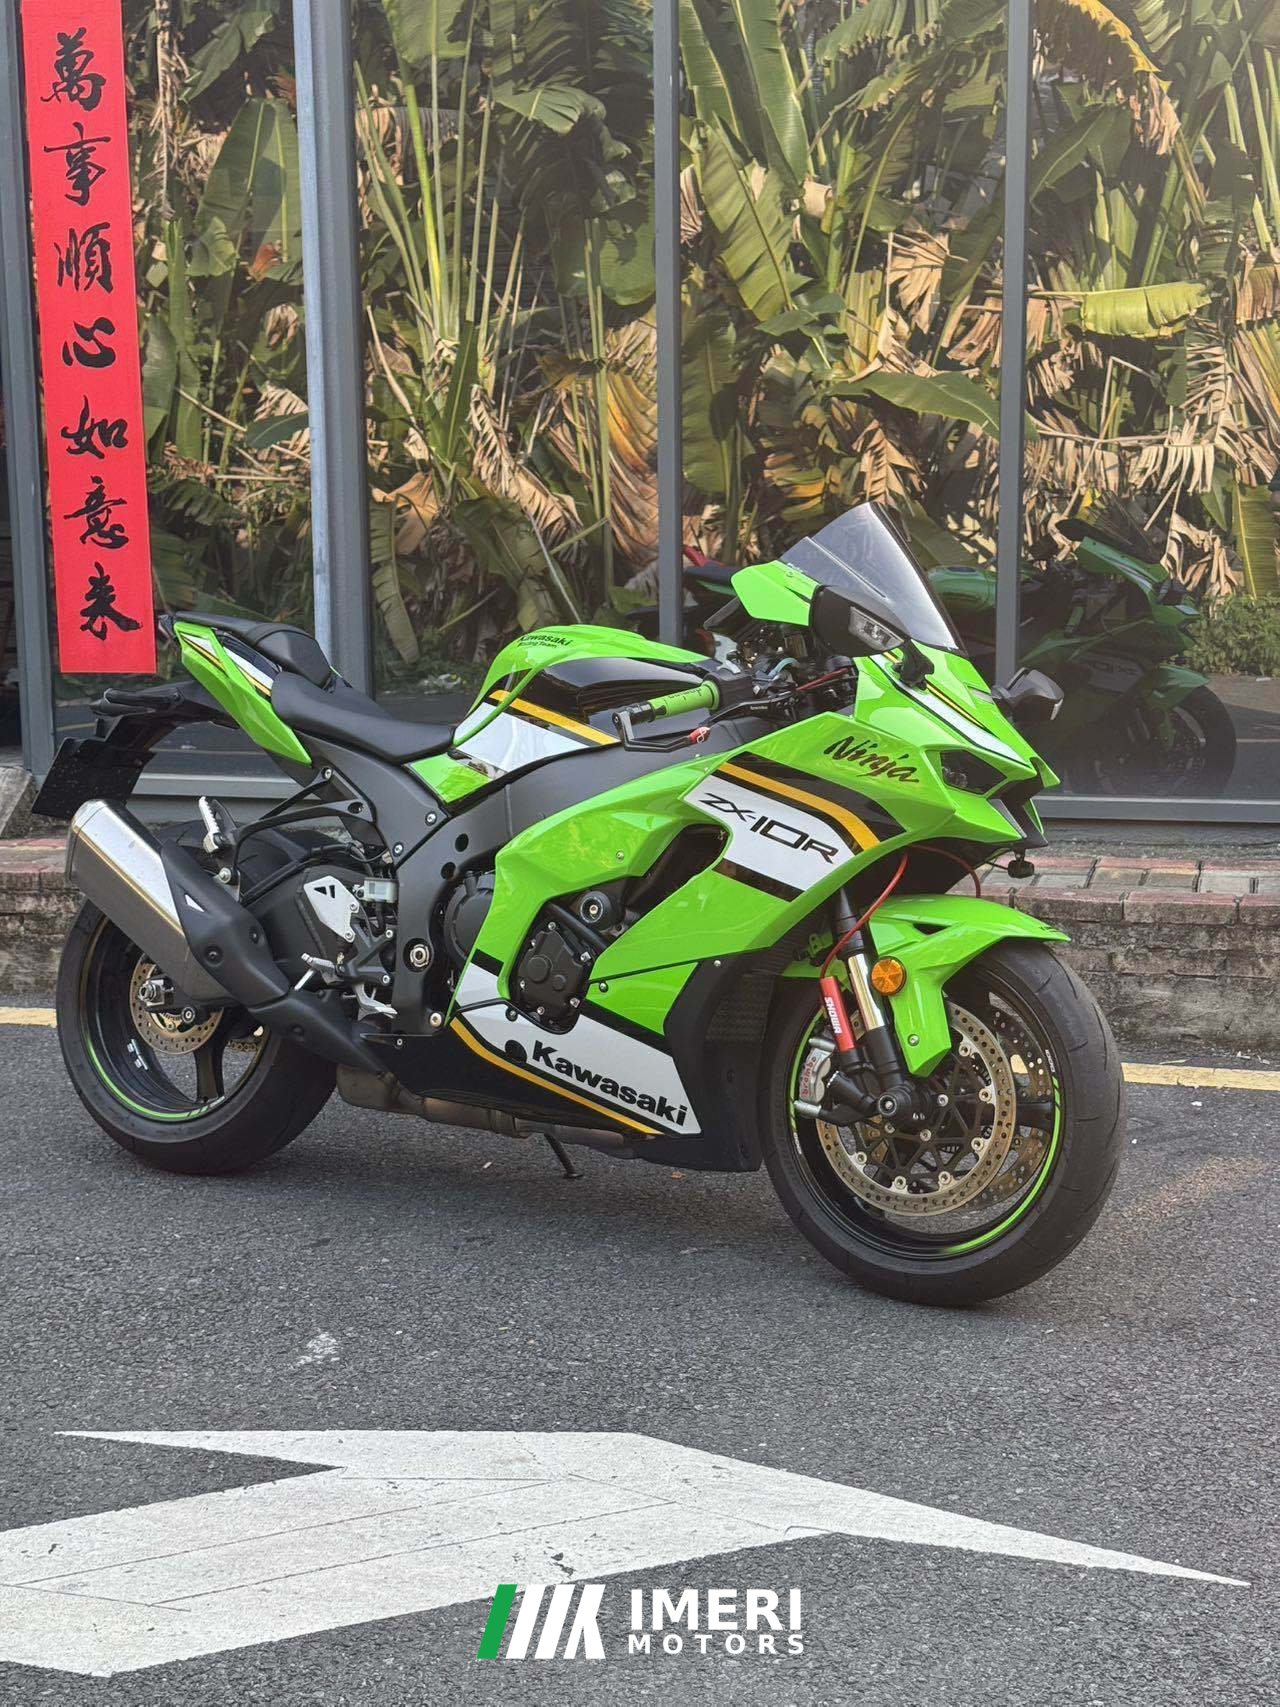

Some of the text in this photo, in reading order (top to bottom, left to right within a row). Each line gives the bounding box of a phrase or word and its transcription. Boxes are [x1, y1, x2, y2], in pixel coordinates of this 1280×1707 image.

[520, 635, 573, 646] Kawasaki
[823, 736, 920, 783] Ninja
[699, 792, 839, 864] ZX-10R
[824, 996, 843, 1034] SHOWA
[532, 1040, 688, 1127] Kawasaki
